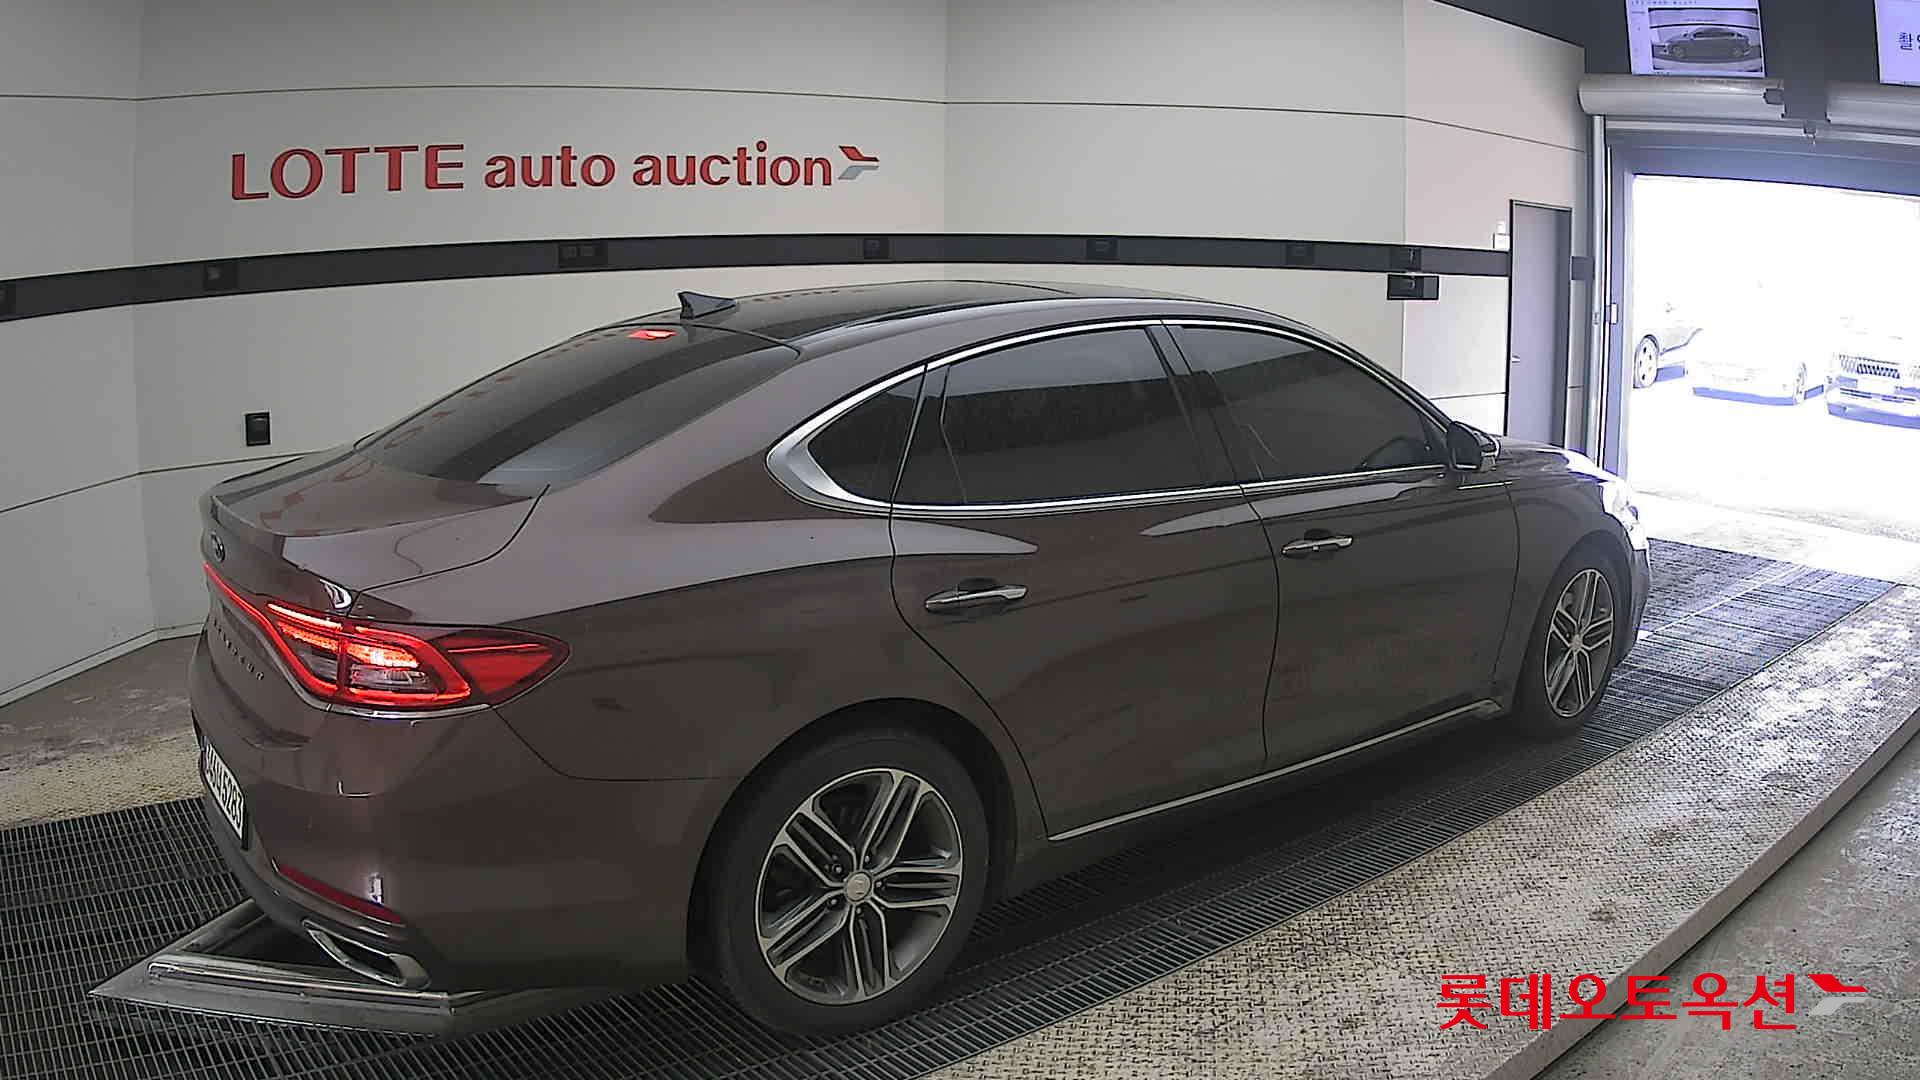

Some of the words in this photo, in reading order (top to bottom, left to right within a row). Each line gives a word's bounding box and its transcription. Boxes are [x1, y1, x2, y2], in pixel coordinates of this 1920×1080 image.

[231, 144, 465, 200] LOTTE
[484, 145, 616, 188] auto
[632, 141, 833, 187] auction
